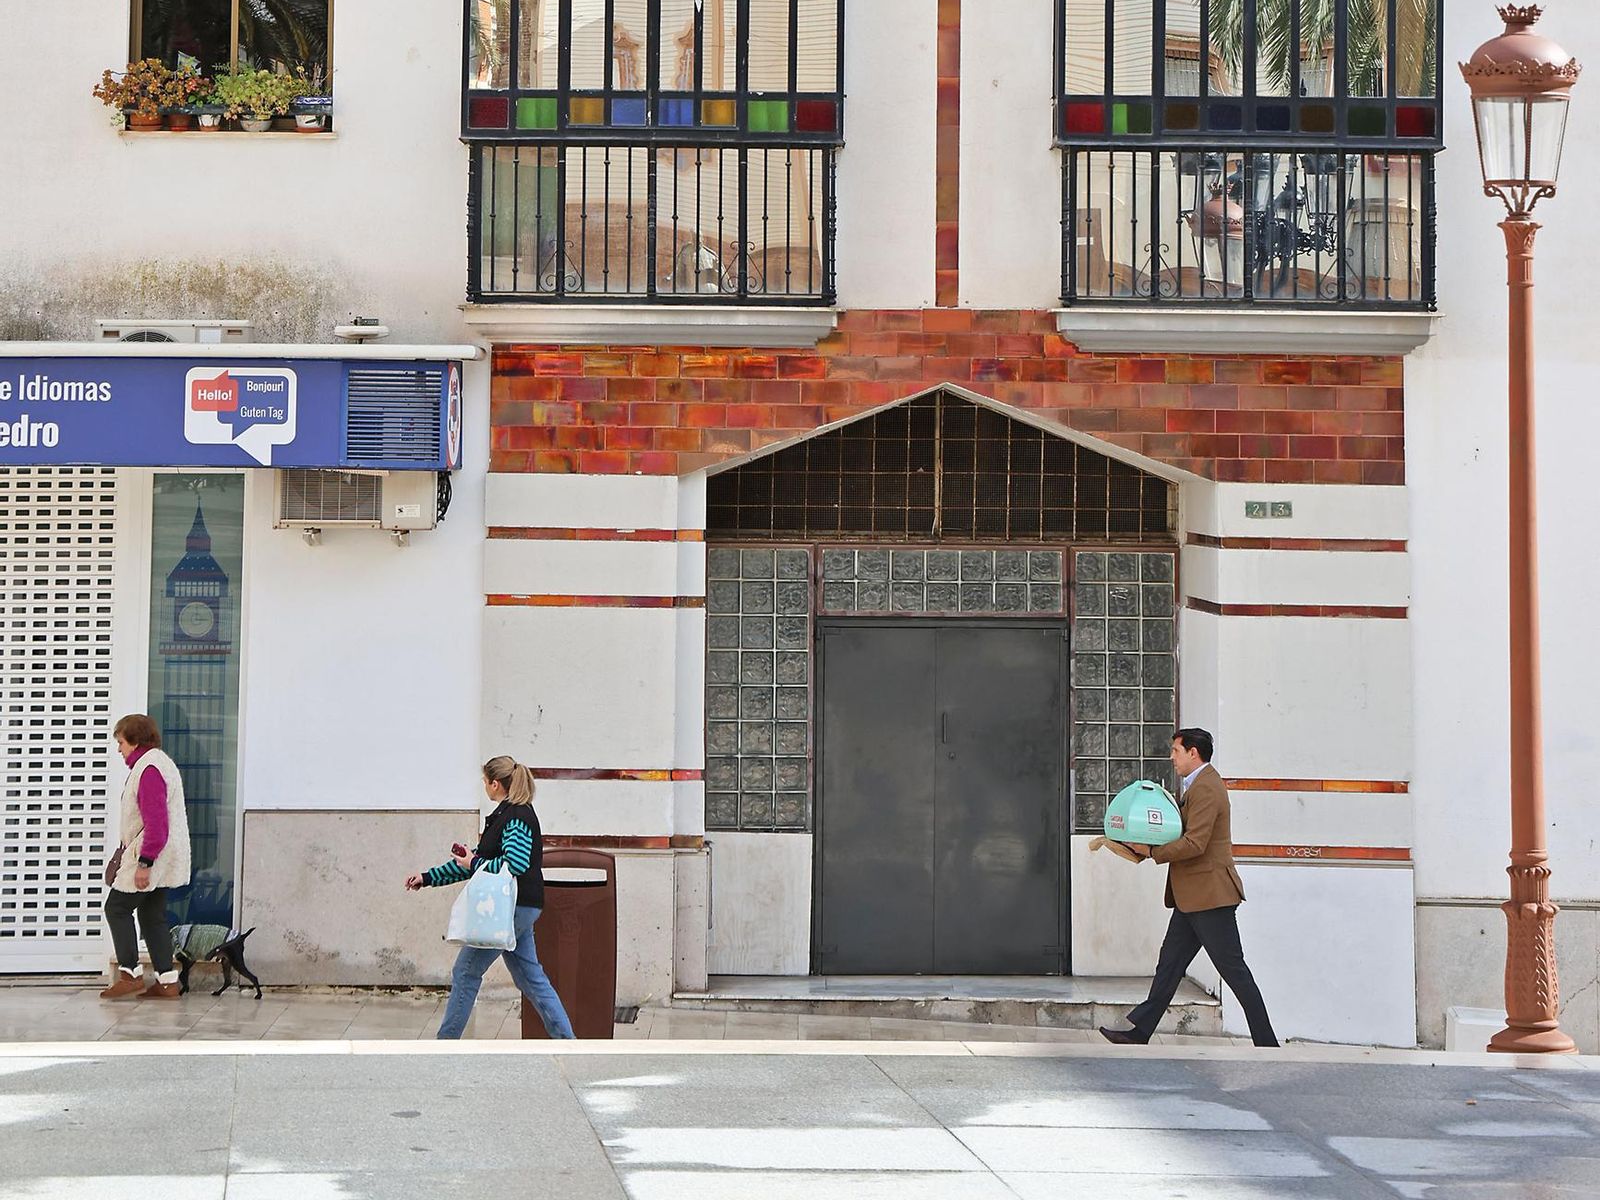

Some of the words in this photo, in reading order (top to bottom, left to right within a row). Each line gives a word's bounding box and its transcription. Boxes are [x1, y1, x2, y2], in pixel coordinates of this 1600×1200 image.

[19, 374, 112, 402] Idiomas
[246, 381, 284, 393] Bonjour!
[198, 389, 232, 401] Hello!
[240, 406, 266, 418] Guten
[267, 406, 284, 420] Tag
[0, 414, 59, 448] edro
